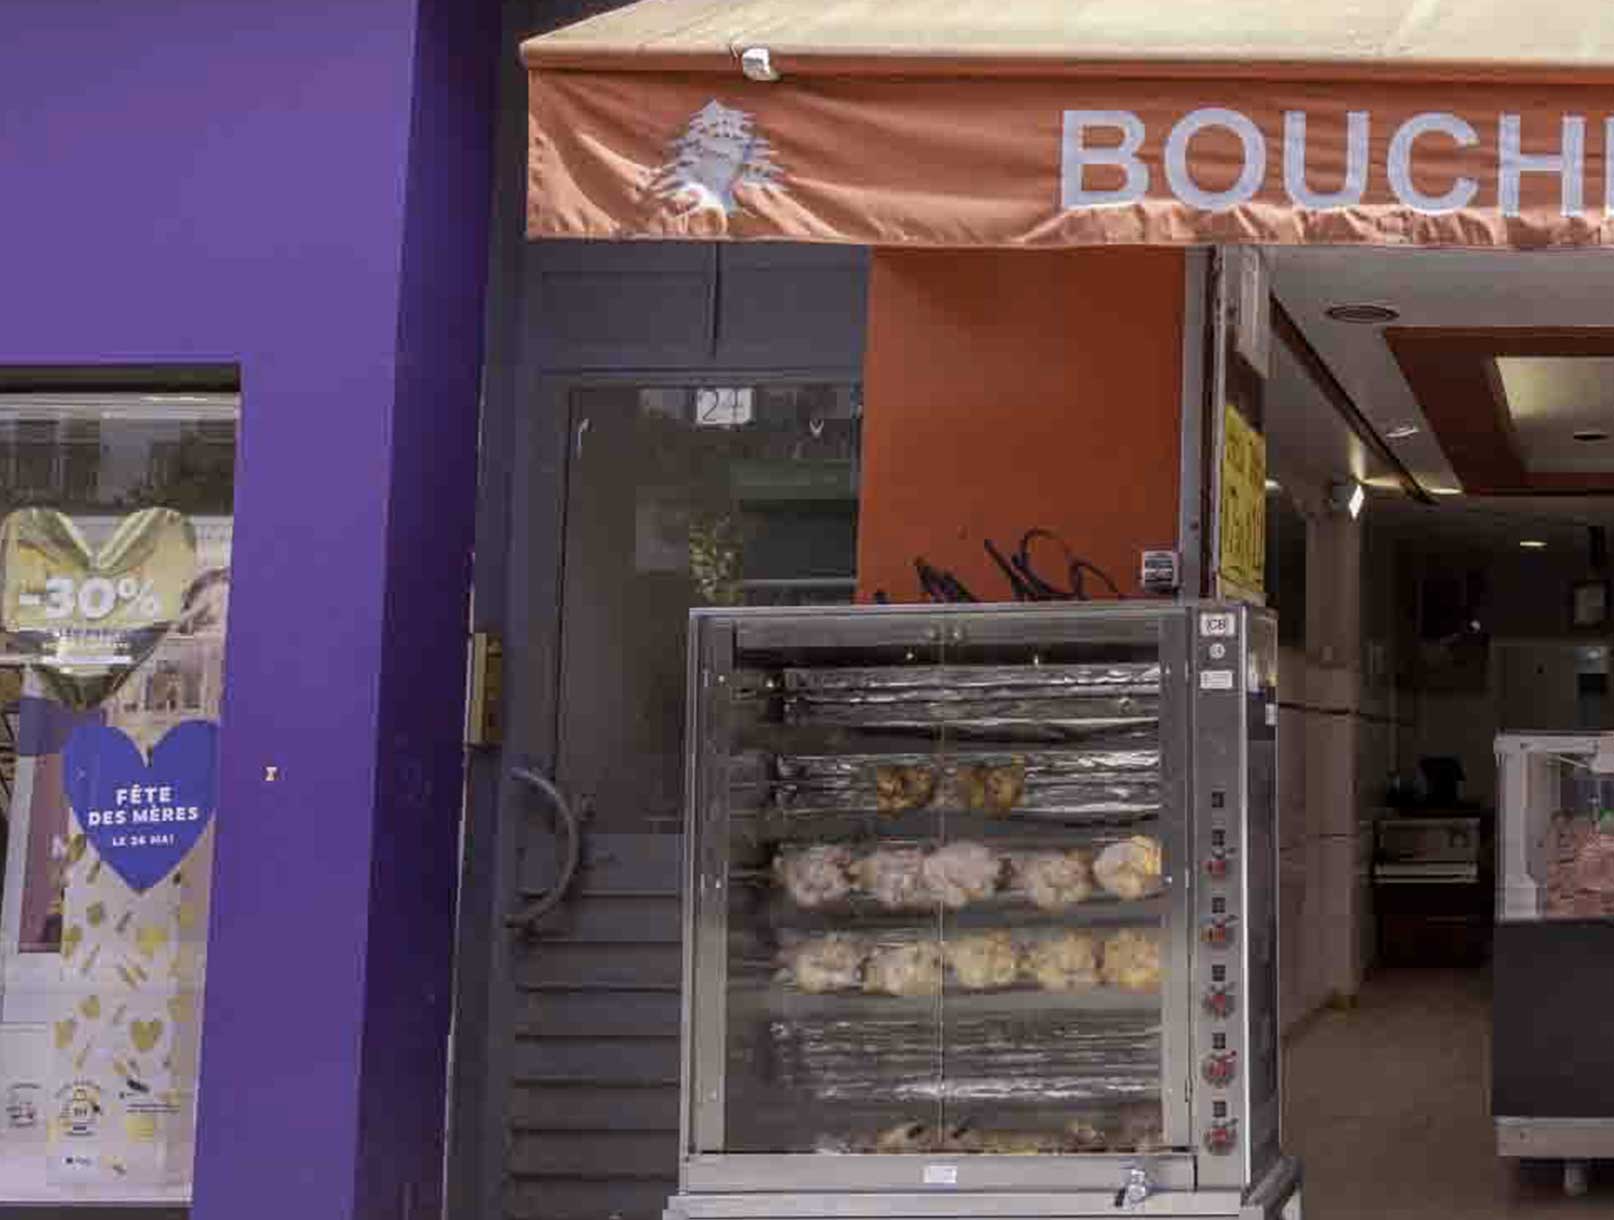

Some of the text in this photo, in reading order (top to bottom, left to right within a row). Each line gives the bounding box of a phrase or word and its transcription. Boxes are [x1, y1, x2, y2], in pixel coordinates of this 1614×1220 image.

[19, 576, 160, 620] -30%
[116, 783, 172, 806] FÊTE
[88, 804, 200, 826] DES MÈRES
[112, 836, 127, 847] LE
[131, 834, 146, 847] 26
